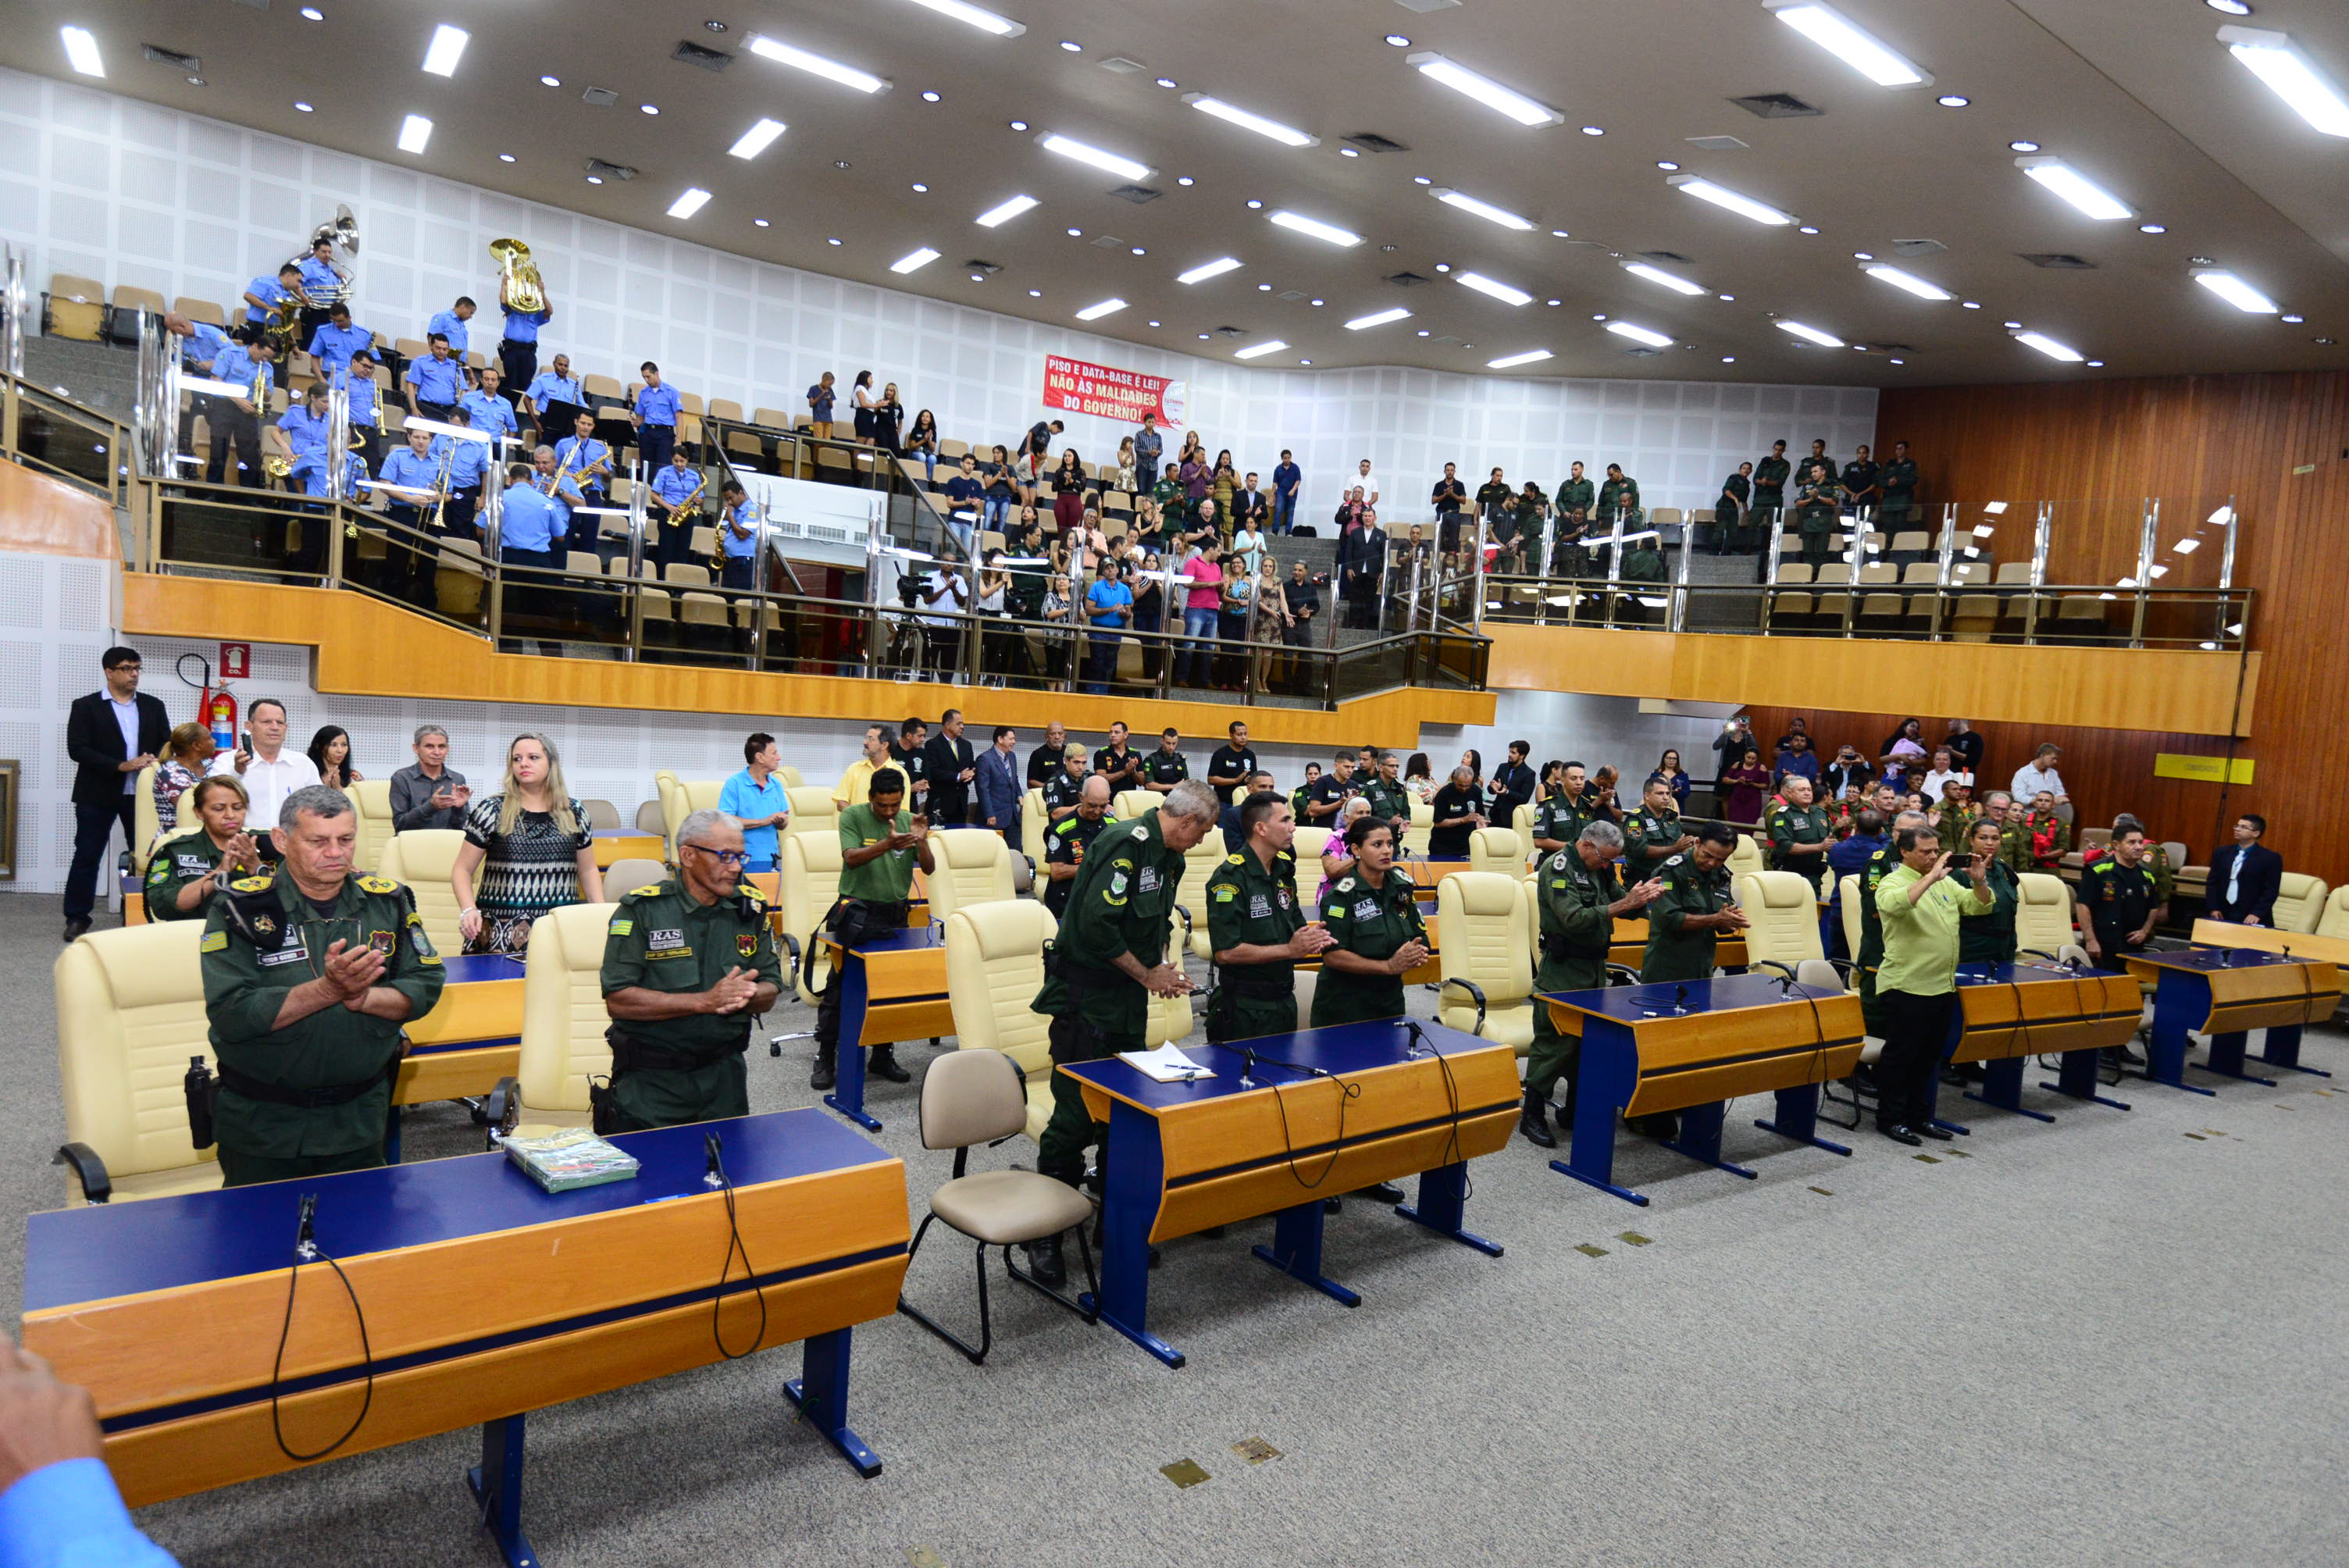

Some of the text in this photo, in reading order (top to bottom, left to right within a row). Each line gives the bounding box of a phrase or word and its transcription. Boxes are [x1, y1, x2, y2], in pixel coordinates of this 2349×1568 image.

[1049, 358, 1160, 391] PISO E DATA-BASE É LEI!
[1050, 373, 1157, 407] NÃO ÀS MALDADES
[1064, 394, 1142, 422] DO GOVERNO!
[1251, 895, 1267, 903] RAS
[1355, 900, 1373, 912] RAS
[652, 930, 681, 941] RAS
